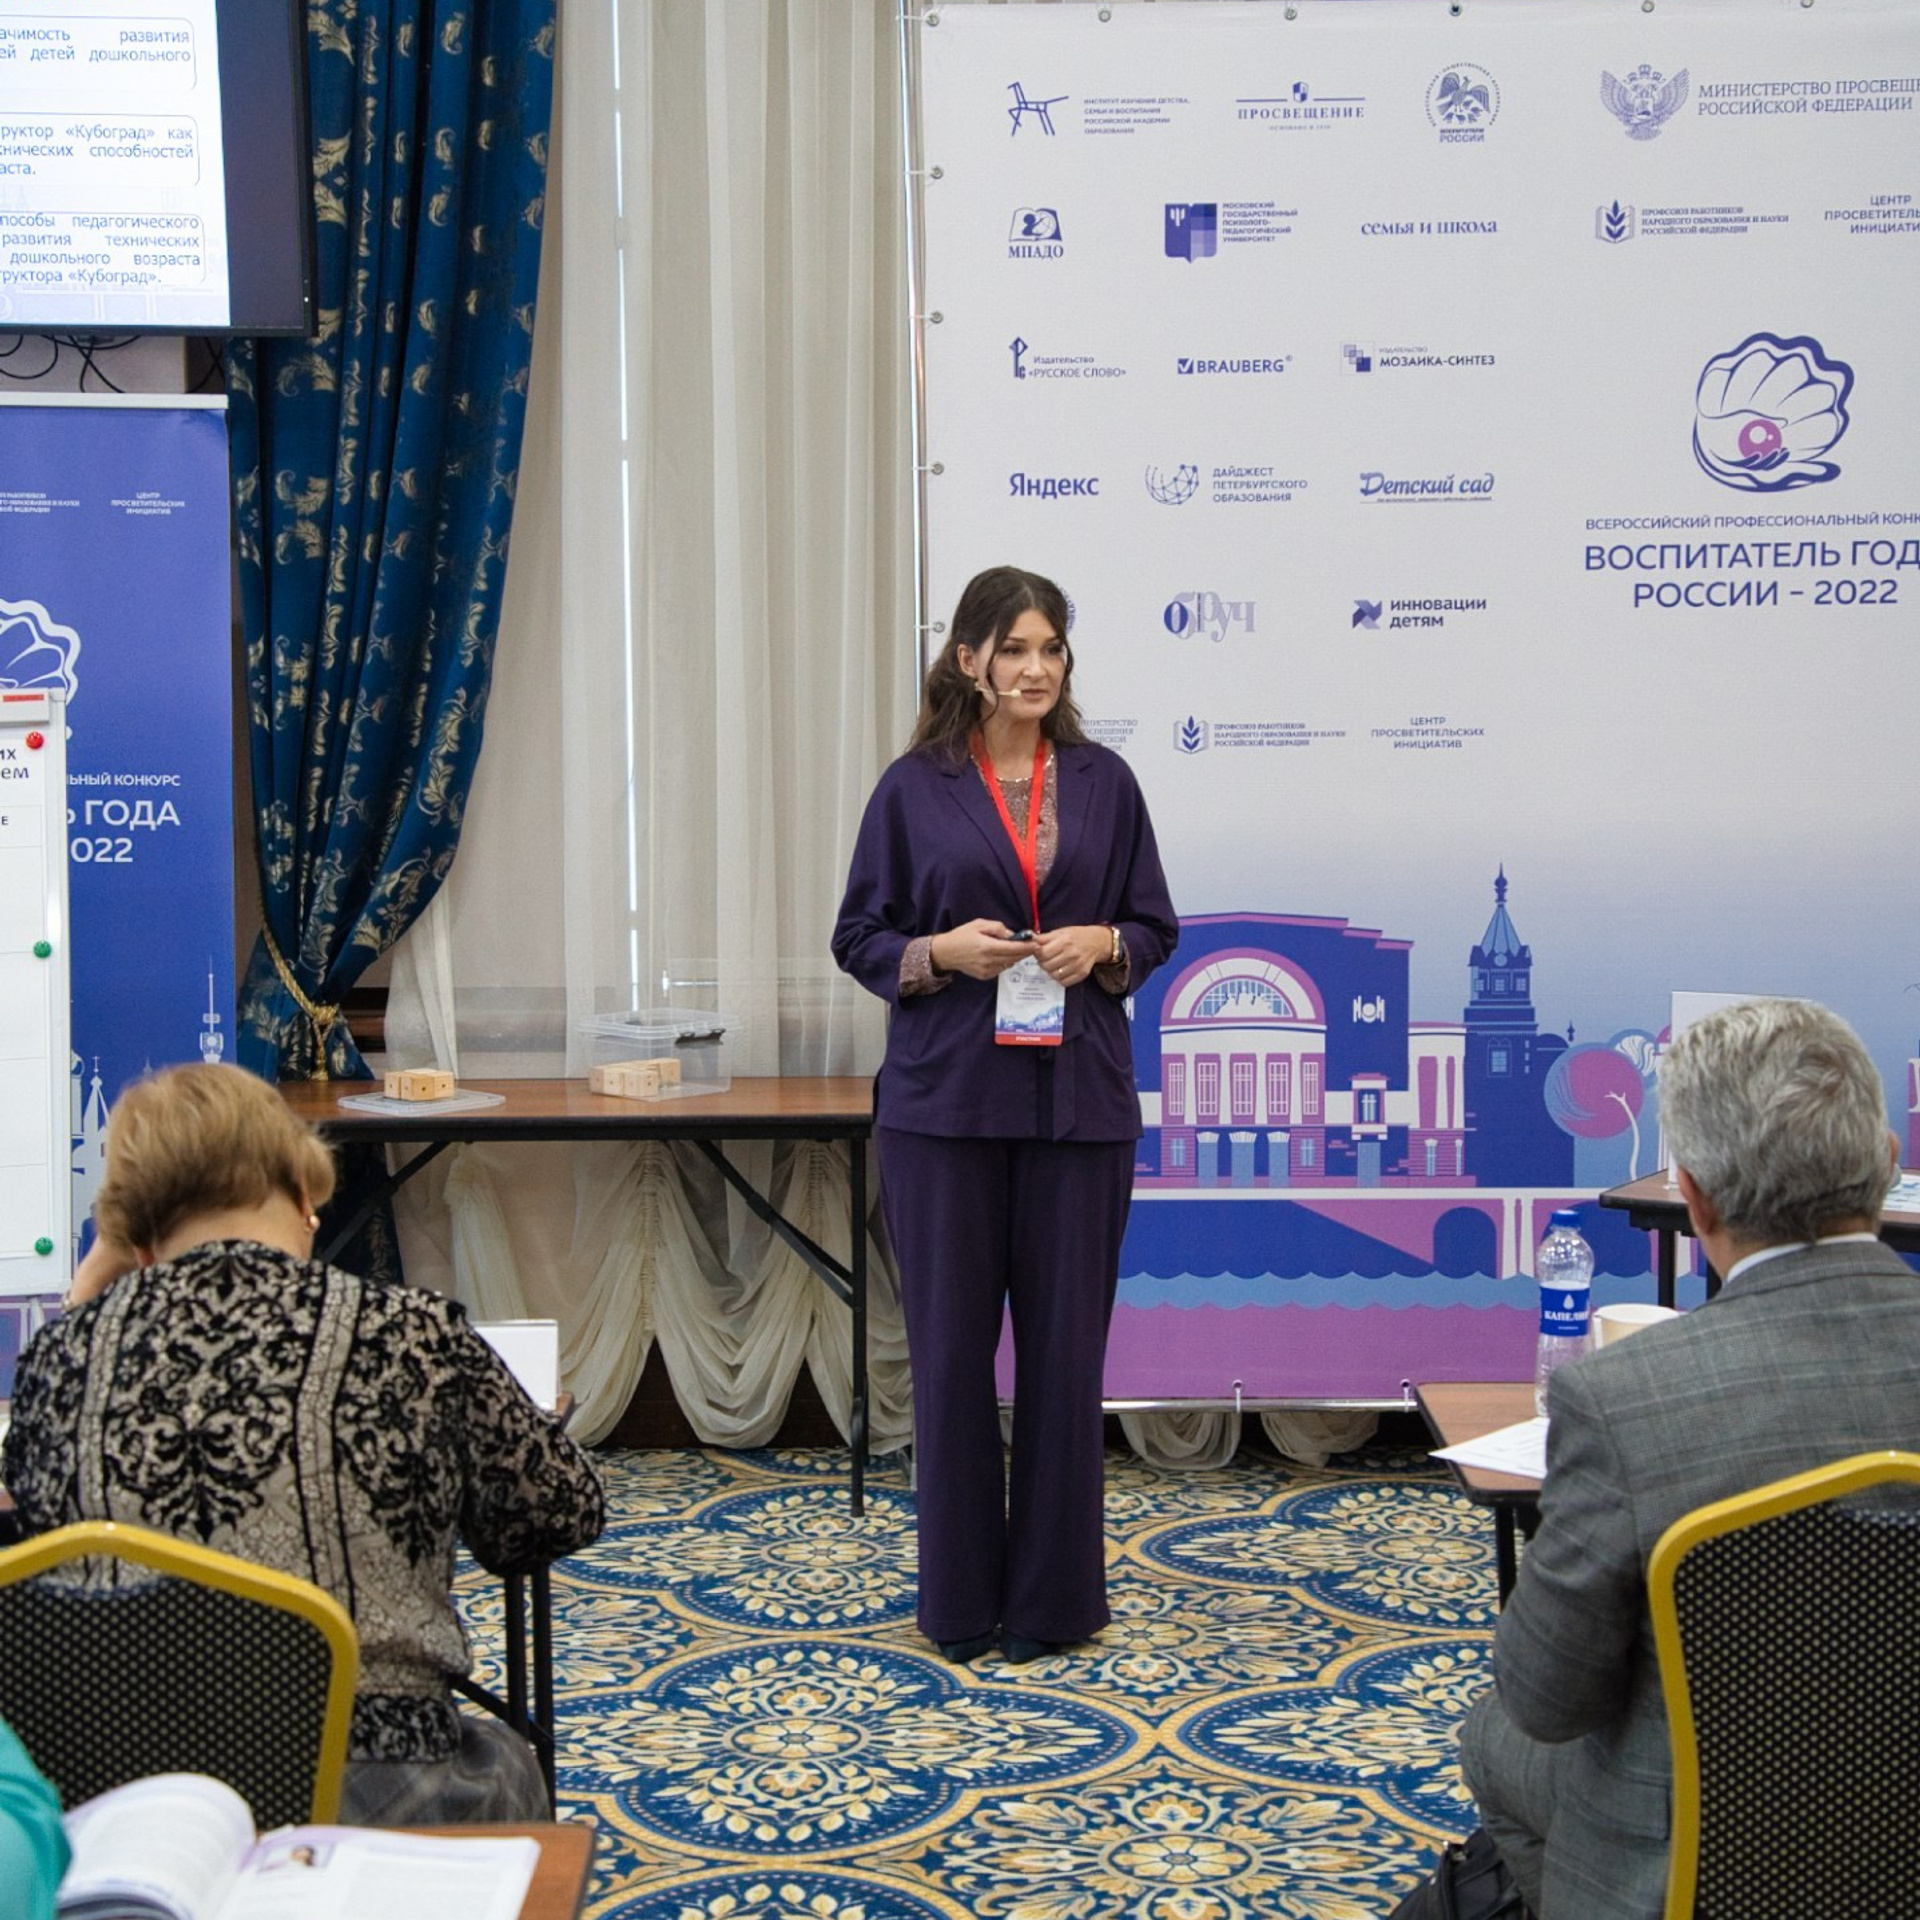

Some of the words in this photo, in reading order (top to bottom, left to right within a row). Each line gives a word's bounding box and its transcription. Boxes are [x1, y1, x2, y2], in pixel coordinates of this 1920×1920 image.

[119, 30, 189, 43] развития
[30, 45, 75, 61] детей
[89, 49, 191, 62] дошкольного
[1699, 81, 1832, 98] МИНИСТЕРСТВО
[1238, 107, 1365, 119] ПРОСВЕЩЕНИЕ
[1698, 99, 1807, 115] РОССИЙСКОЙ
[1812, 97, 1913, 113] ФЕДЕРАЦИИ
[65, 124, 155, 140] «Кубоград»
[168, 128, 193, 140] как
[1439, 134, 1485, 143] РОССИИ
[0, 145, 74, 157] нических
[89, 143, 194, 158] способностей
[1870, 195, 1912, 206] ЦЕНТР
[72, 216, 199, 230] педагогического
[2, 234, 72, 248] развития
[105, 235, 200, 248] технических
[10, 252, 111, 265] дошкольного
[134, 253, 201, 267] возраста
[1008, 245, 1064, 260] МПАДО
[0, 269, 63, 285] руктора
[68, 268, 162, 286] «Кубоград».
[1033, 356, 1095, 364] Издательство
[1197, 359, 1284, 373] BRAUBERG
[1380, 355, 1496, 367] МОЗАИКА-СИНТЕЗ
[1029, 368, 1081, 378] «РУССКОЕ
[1083, 367, 1127, 378] СЛОВО»
[1213, 466, 1274, 478] ДАЙДЖЕСТ
[1009, 473, 1100, 499] Яндекс
[1213, 480, 1308, 490] ПЕТЕРБУРГСКОГО
[1360, 472, 1455, 496] Детский
[1459, 473, 1495, 493] сад
[1213, 494, 1292, 503] ОБРАЗОВАНИЯ
[1586, 514, 1711, 530] ВСЕРОССИЙСКИЙ
[1714, 511, 1879, 528] ПРОФЕССИОНАЛЬНЫЙ
[1585, 542, 1841, 571] ВОСПИТАТЕЛЬ
[1633, 581, 1778, 608] РОССИИ
[1814, 579, 1898, 605] 2022
[1390, 599, 1487, 612] инновации
[1389, 615, 1445, 629] детям
[1410, 717, 1446, 726] ЦЕНТР
[1371, 728, 1485, 737] ПРОСВЕТИТЕЛЬСКИХ
[1394, 740, 1463, 749] ИНИЦИАТИВ
[67, 772, 112, 786] ЬНЫЙ
[114, 774, 181, 787] КОНКУРС
[85, 799, 181, 831] ГОДА
